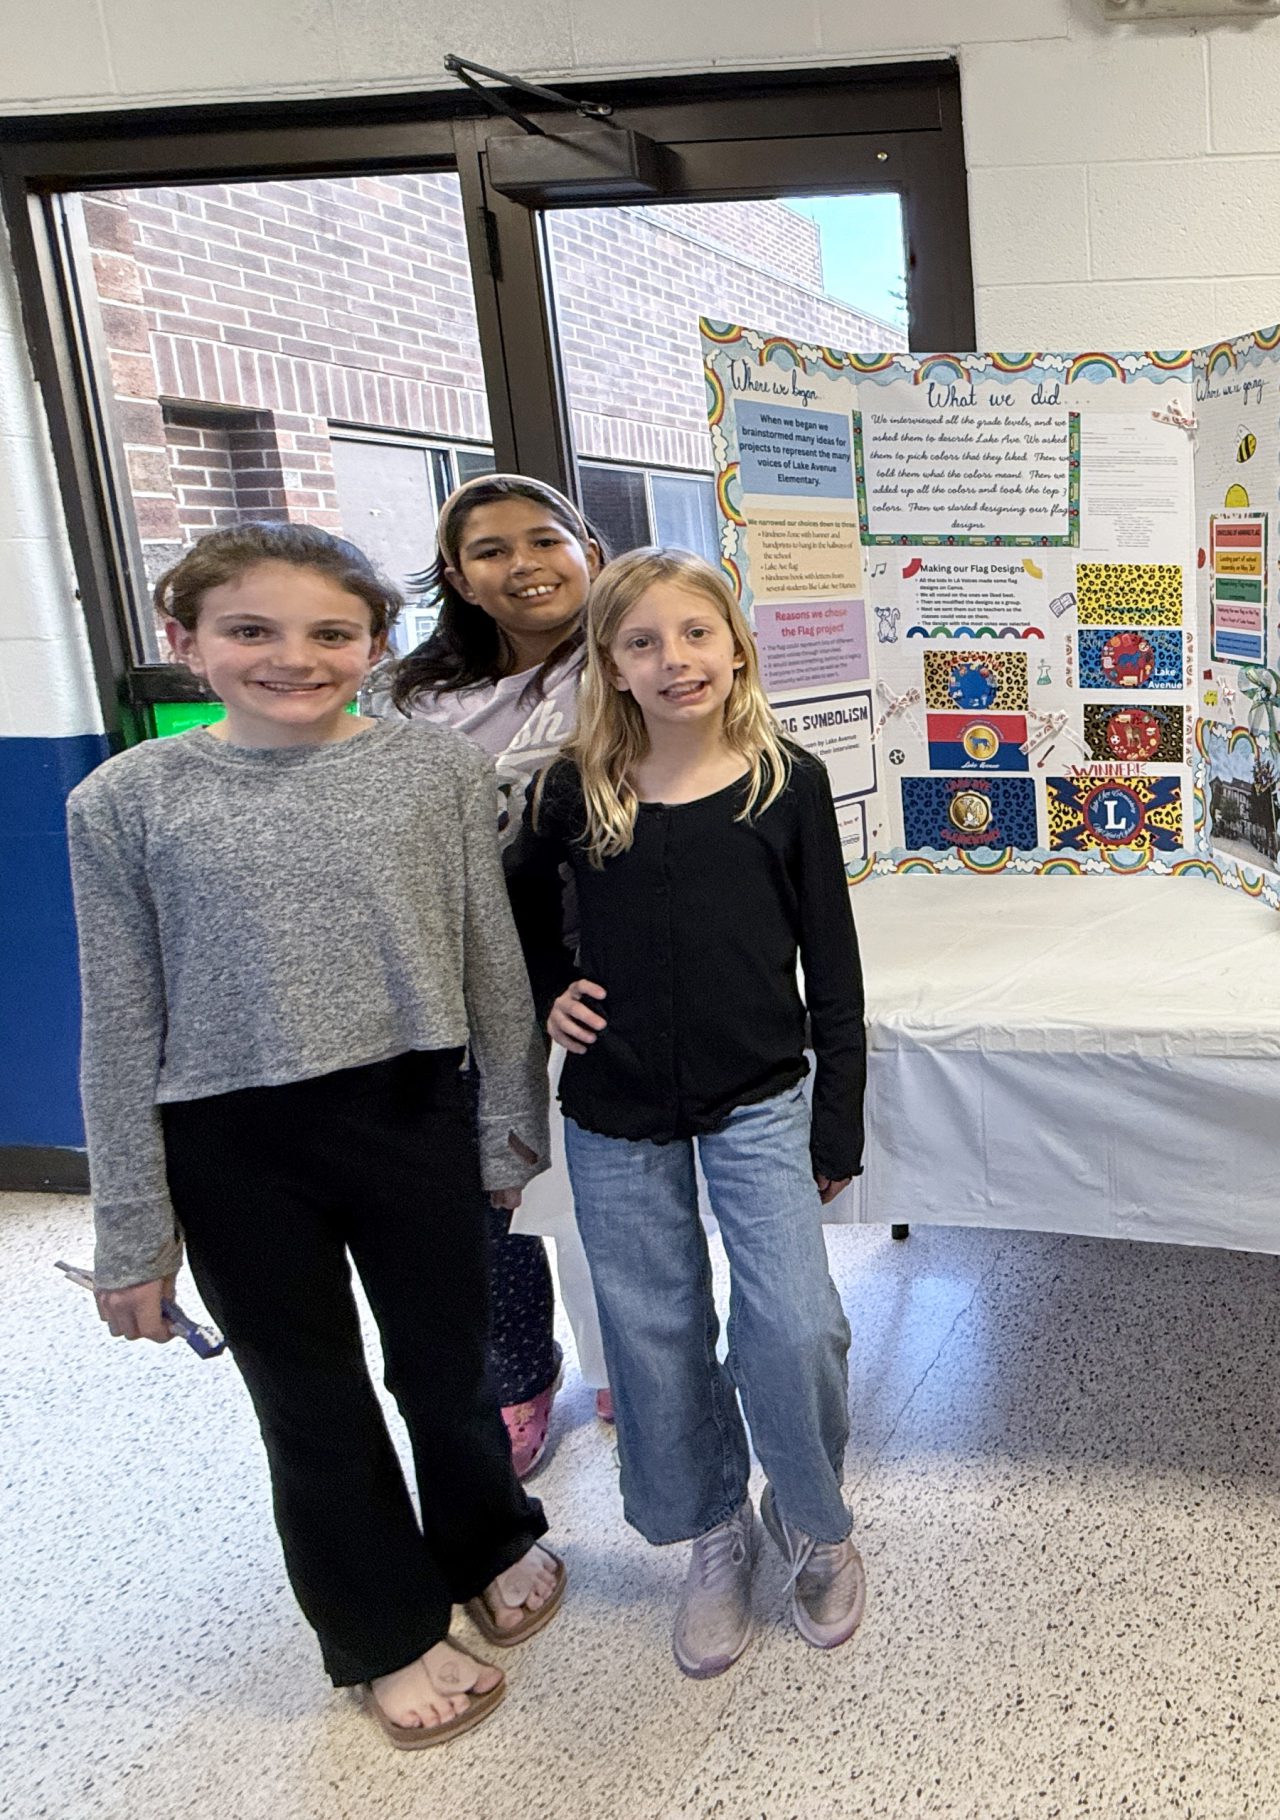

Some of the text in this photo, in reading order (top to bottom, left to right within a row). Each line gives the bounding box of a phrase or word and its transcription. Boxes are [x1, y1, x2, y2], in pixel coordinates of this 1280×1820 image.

[727, 359, 770, 393] Where
[772, 381, 789, 396] we
[926, 382, 977, 408] What
[989, 394, 1015, 406] we
[760, 413, 829, 432] When we began we
[871, 414, 888, 424] We
[889, 415, 943, 425] interviewed
[945, 414, 960, 424] all
[961, 415, 975, 424] the
[976, 416, 1002, 429] grade
[1004, 416, 1032, 428] levels,
[1034, 417, 1052, 426] and
[742, 426, 847, 447] brainstormed many ideas for
[872, 432, 898, 442] asked
[901, 432, 923, 442] them
[925, 433, 936, 442] to
[938, 433, 973, 442] describe
[975, 433, 999, 444] Lake
[1023, 434, 1040, 444] We
[1041, 434, 1068, 444] asked
[739, 442, 850, 464] projects to represent the many
[869, 451, 892, 460] them
[895, 451, 905, 460] to
[905, 450, 928, 464] pick
[930, 450, 960, 460] colors
[962, 451, 980, 461] that
[982, 451, 1003, 464] they
[1034, 452, 1057, 461] Then
[757, 459, 837, 473] voices of Lake Avenue
[777, 473, 821, 488] Elementary.
[876, 468, 895, 478] told
[897, 468, 920, 478] them
[923, 469, 945, 478] what
[947, 469, 961, 478] the
[963, 469, 992, 479] colors
[1029, 470, 1052, 479] Then
[872, 484, 898, 494] added
[900, 488, 914, 498] up
[916, 484, 930, 493] all
[932, 484, 946, 493] the
[947, 484, 976, 494] colors
[978, 483, 998, 493] and
[1000, 484, 1023, 494] took
[1025, 484, 1040, 494] the
[1042, 486, 1060, 498] top
[908, 502, 931, 512] Then
[947, 502, 978, 512] started
[980, 502, 1027, 516] designing
[1049, 503, 1069, 517] flag
[798, 519, 818, 527] choices
[920, 563, 1025, 574] Making our Flag Designs
[775, 608, 848, 622] Reasons we chose
[781, 623, 845, 637] the Flag project
[1155, 667, 1177, 676] Lake
[1148, 681, 1183, 689] Avenue
[1071, 763, 1140, 776] WINNER!
[1103, 800, 1127, 830] L
